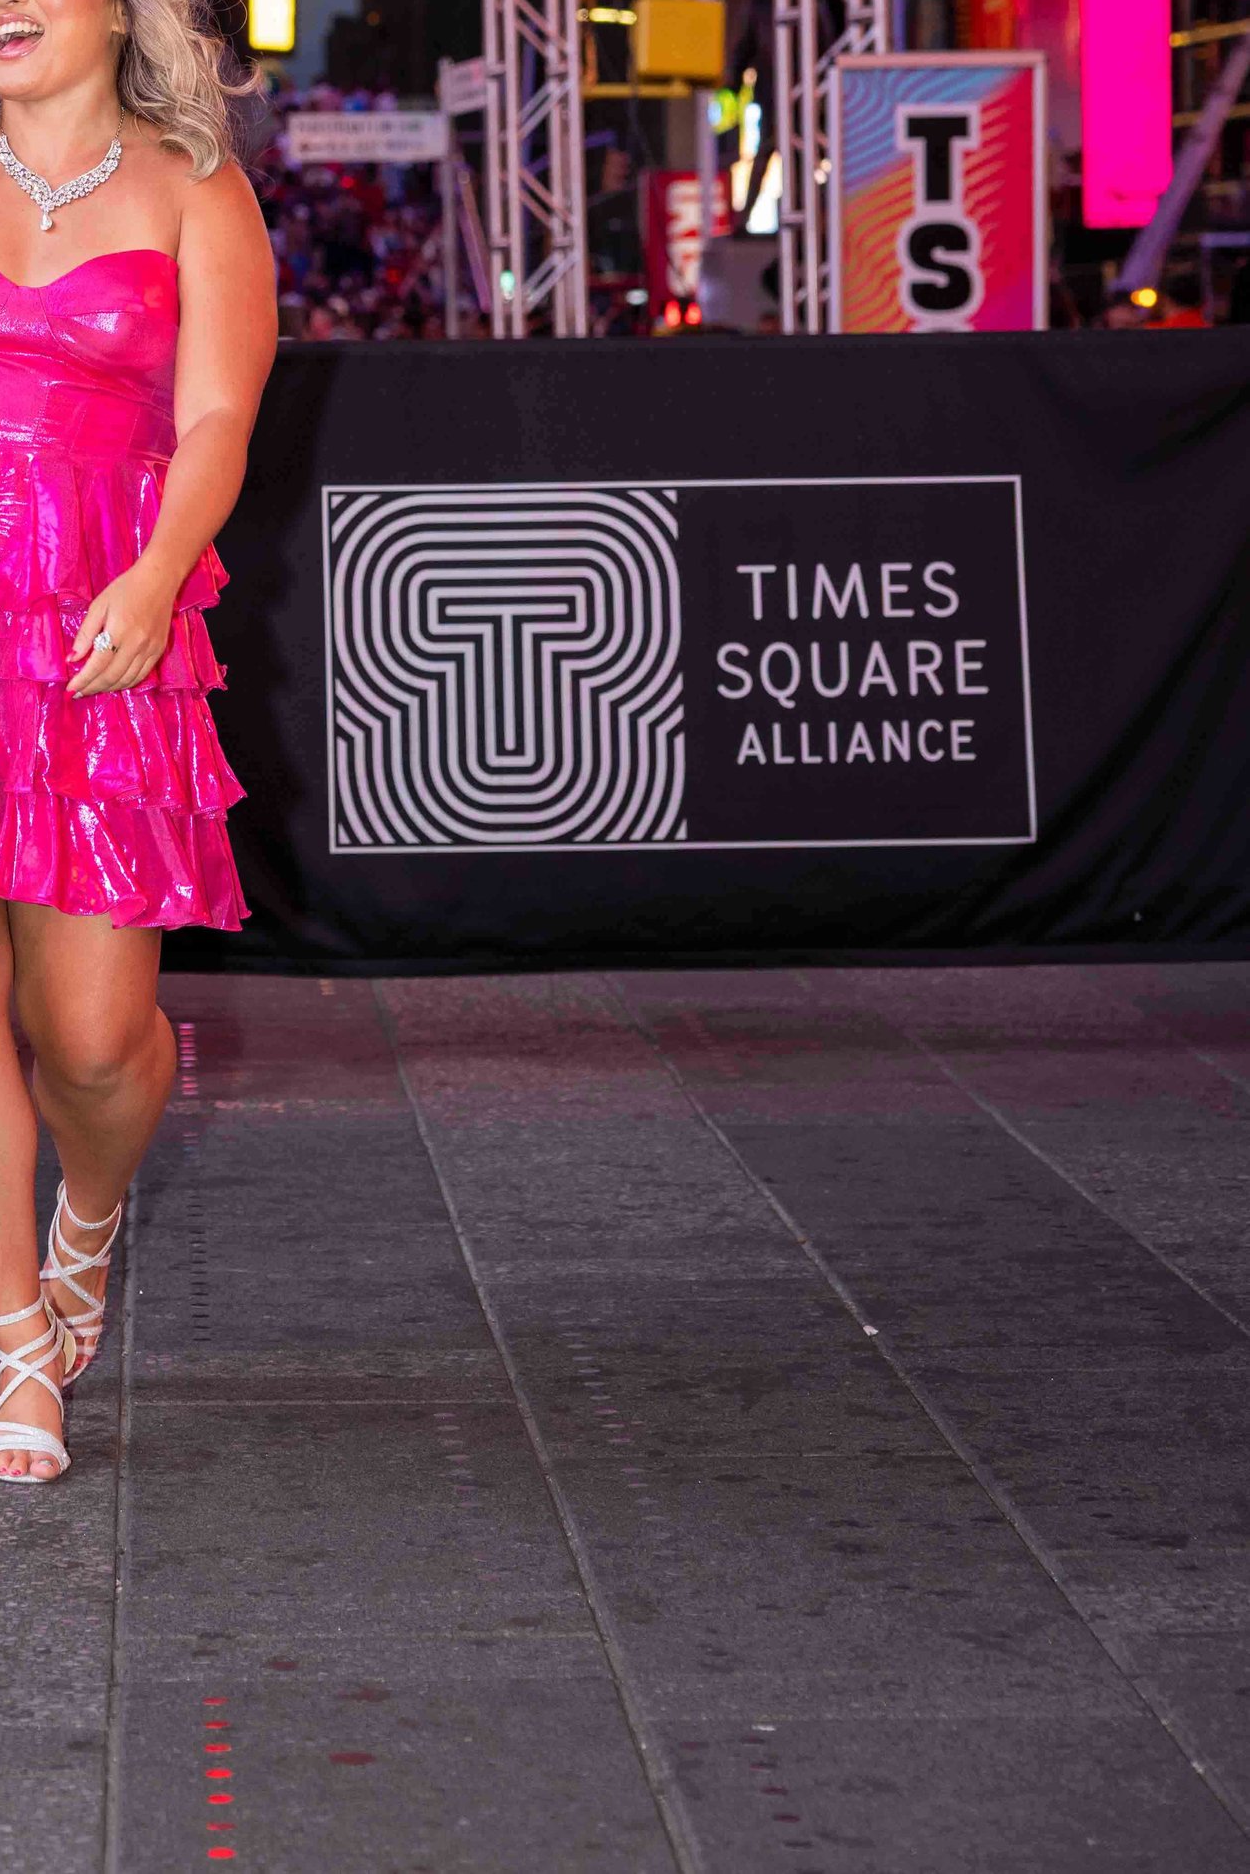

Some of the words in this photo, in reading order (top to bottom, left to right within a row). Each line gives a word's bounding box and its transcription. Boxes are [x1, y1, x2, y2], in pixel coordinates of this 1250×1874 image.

[737, 561, 959, 620] TIMES
[716, 639, 988, 708] SQUARE
[737, 720, 976, 764] ALLIANCE
